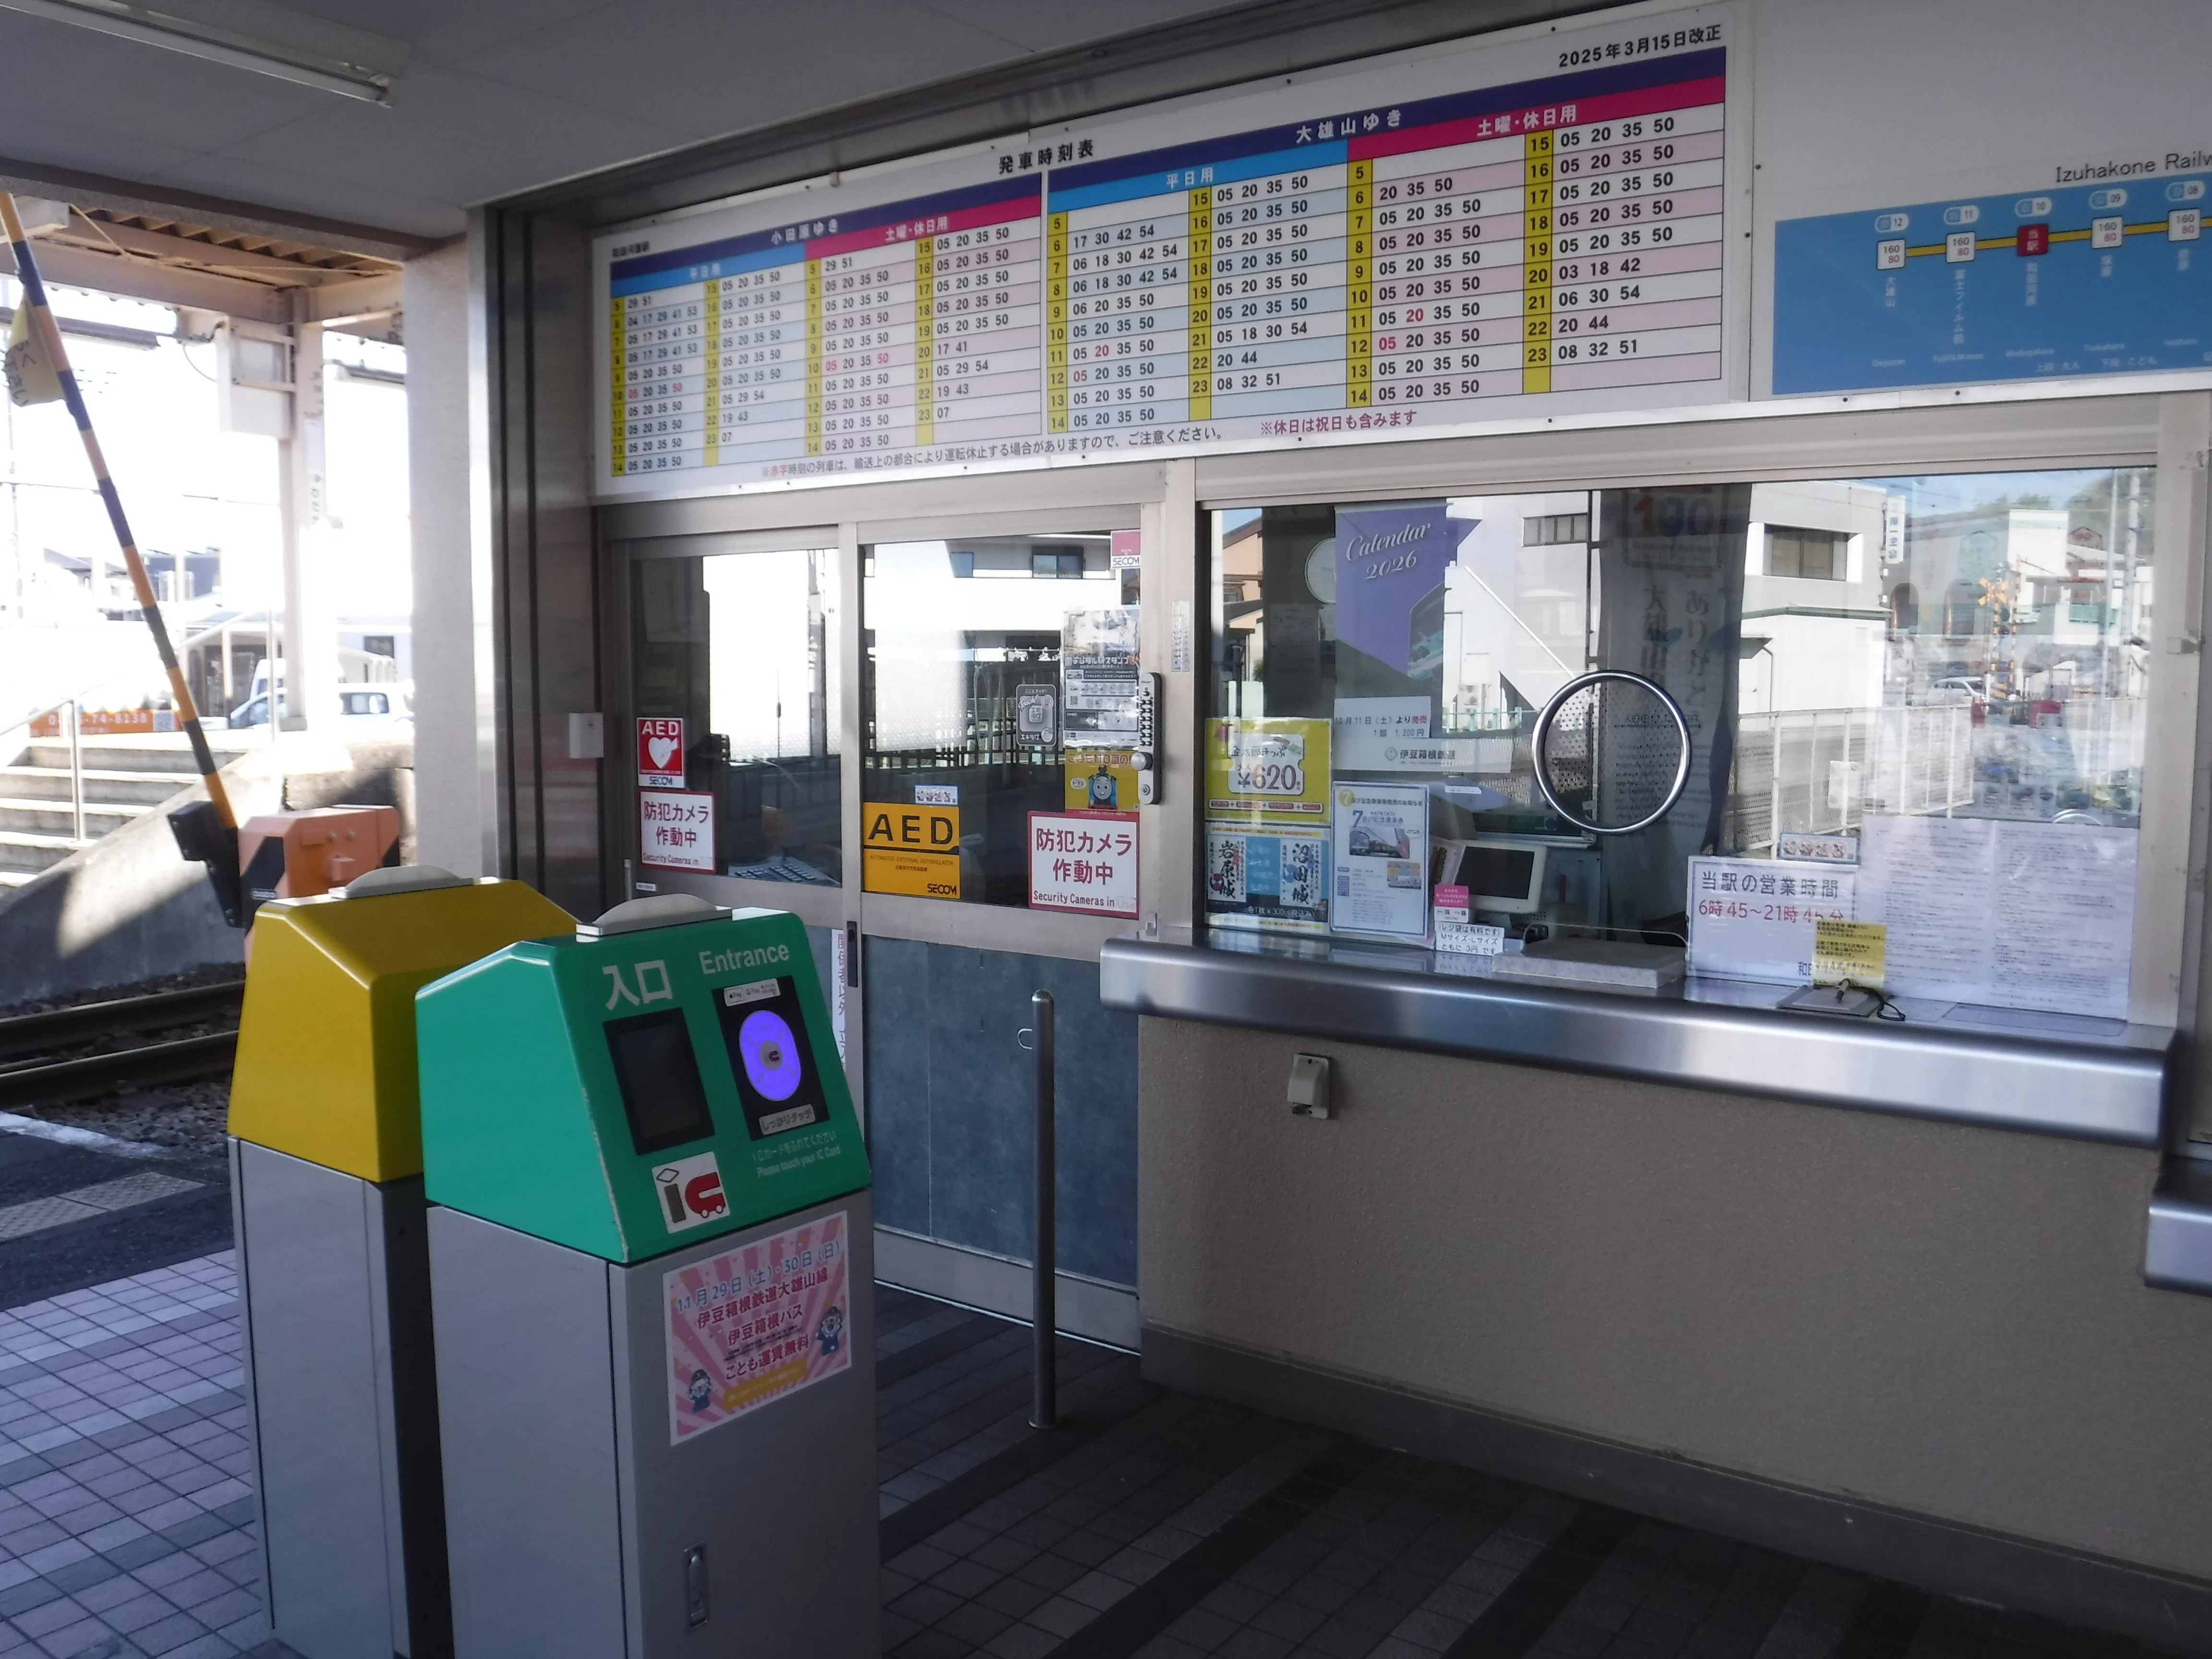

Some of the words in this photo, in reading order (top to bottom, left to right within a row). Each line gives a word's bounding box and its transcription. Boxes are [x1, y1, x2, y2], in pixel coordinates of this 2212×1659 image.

[1559, 24, 1721, 67] 2025年3月15日改正
[1296, 109, 1401, 144] 大雄山ゆき
[1477, 104, 1577, 137] 土曜・休日用
[1531, 136, 1549, 152] 15
[1561, 131, 1580, 147] 05
[1591, 126, 1611, 143] 20
[1622, 121, 1642, 138] 35
[1653, 117, 1674, 133] 50
[999, 139, 1093, 174] 発車時刻表
[1166, 167, 1213, 189] 平日用
[2056, 160, 2155, 183] Izuhakone
[1355, 191, 1364, 204] 6
[1380, 185, 1397, 201] 20
[1407, 181, 1425, 196] 35
[1434, 177, 1453, 192] 50
[2110, 193, 2121, 203] 09
[2188, 185, 2199, 195] 08
[1964, 209, 1973, 218] 11
[2036, 201, 2045, 211] 10
[1893, 217, 1903, 227] 12
[2098, 221, 2117, 232] 160
[2176, 214, 2195, 224] 160
[2181, 225, 2195, 234] 80
[919, 242, 930, 253] 15
[937, 238, 950, 250] 05
[956, 234, 969, 246] 20
[976, 230, 989, 243] 35
[996, 227, 1009, 240] 50
[1953, 237, 1969, 247] 160
[2104, 232, 2117, 242] 80
[1054, 262, 1060, 274] 7
[1073, 257, 1087, 271] 06
[1095, 254, 1109, 267] 18
[1117, 251, 1131, 264] 30
[1139, 247, 1154, 260] 42
[1162, 243, 1178, 257] 54
[1883, 244, 1900, 254] 160
[1888, 254, 1900, 264] 80
[1957, 247, 1969, 257] 80
[1528, 268, 1548, 284] 20
[1559, 264, 1578, 280] 03
[1590, 261, 1609, 276] 18
[1620, 257, 1640, 273] 42
[1192, 333, 1206, 346] 21
[1217, 330, 1233, 343] 05
[1242, 327, 1257, 340] 18
[1266, 324, 1282, 338] 30
[1291, 321, 1308, 335] 54
[1351, 339, 1368, 353] 12
[1379, 336, 1396, 350] 05
[1406, 333, 1424, 348] 20
[1433, 330, 1452, 346] 35
[1461, 327, 1480, 343] 50
[1527, 347, 1547, 362] 23
[1558, 344, 1578, 360] 08
[1588, 342, 1608, 357] 32
[1619, 339, 1637, 354] 51
[919, 367, 929, 378] 21
[937, 364, 949, 376] 05
[956, 361, 969, 373] 29
[976, 360, 989, 372] 54
[1261, 409, 1418, 435] ※休日は祝日も含みます
[1346, 523, 1431, 562] Calendar
[1113, 556, 1140, 566] SECOM
[1366, 549, 1417, 579] 2026
[642, 721, 678, 735] AED
[649, 776, 673, 785] SECOM
[644, 801, 709, 823] 防犯カメラ
[656, 826, 697, 847] 作動中
[868, 814, 953, 844] AED
[1036, 828, 1132, 856] 防犯カメラ
[643, 853, 666, 863] Security
[668, 855, 691, 865] Cameras
[1053, 858, 1113, 885] 作動中
[927, 883, 957, 895] SECOM
[1702, 871, 1838, 898] 当駅の営業時間
[1034, 890, 1068, 904] Security
[1070, 893, 1104, 906] Cameras
[1106, 896, 1114, 907] in
[1442, 943, 1461, 951] ともに
[698, 944, 789, 974] Entrance
[602, 960, 673, 1011] 入口
[761, 1108, 811, 1130] しっかりタッチ
[697, 1267, 828, 1329] 伊豆箱根鉄道大雄山線
[728, 1304, 803, 1346] 伊豆箱根バス
[726, 1334, 809, 1380] こども運賃無料
